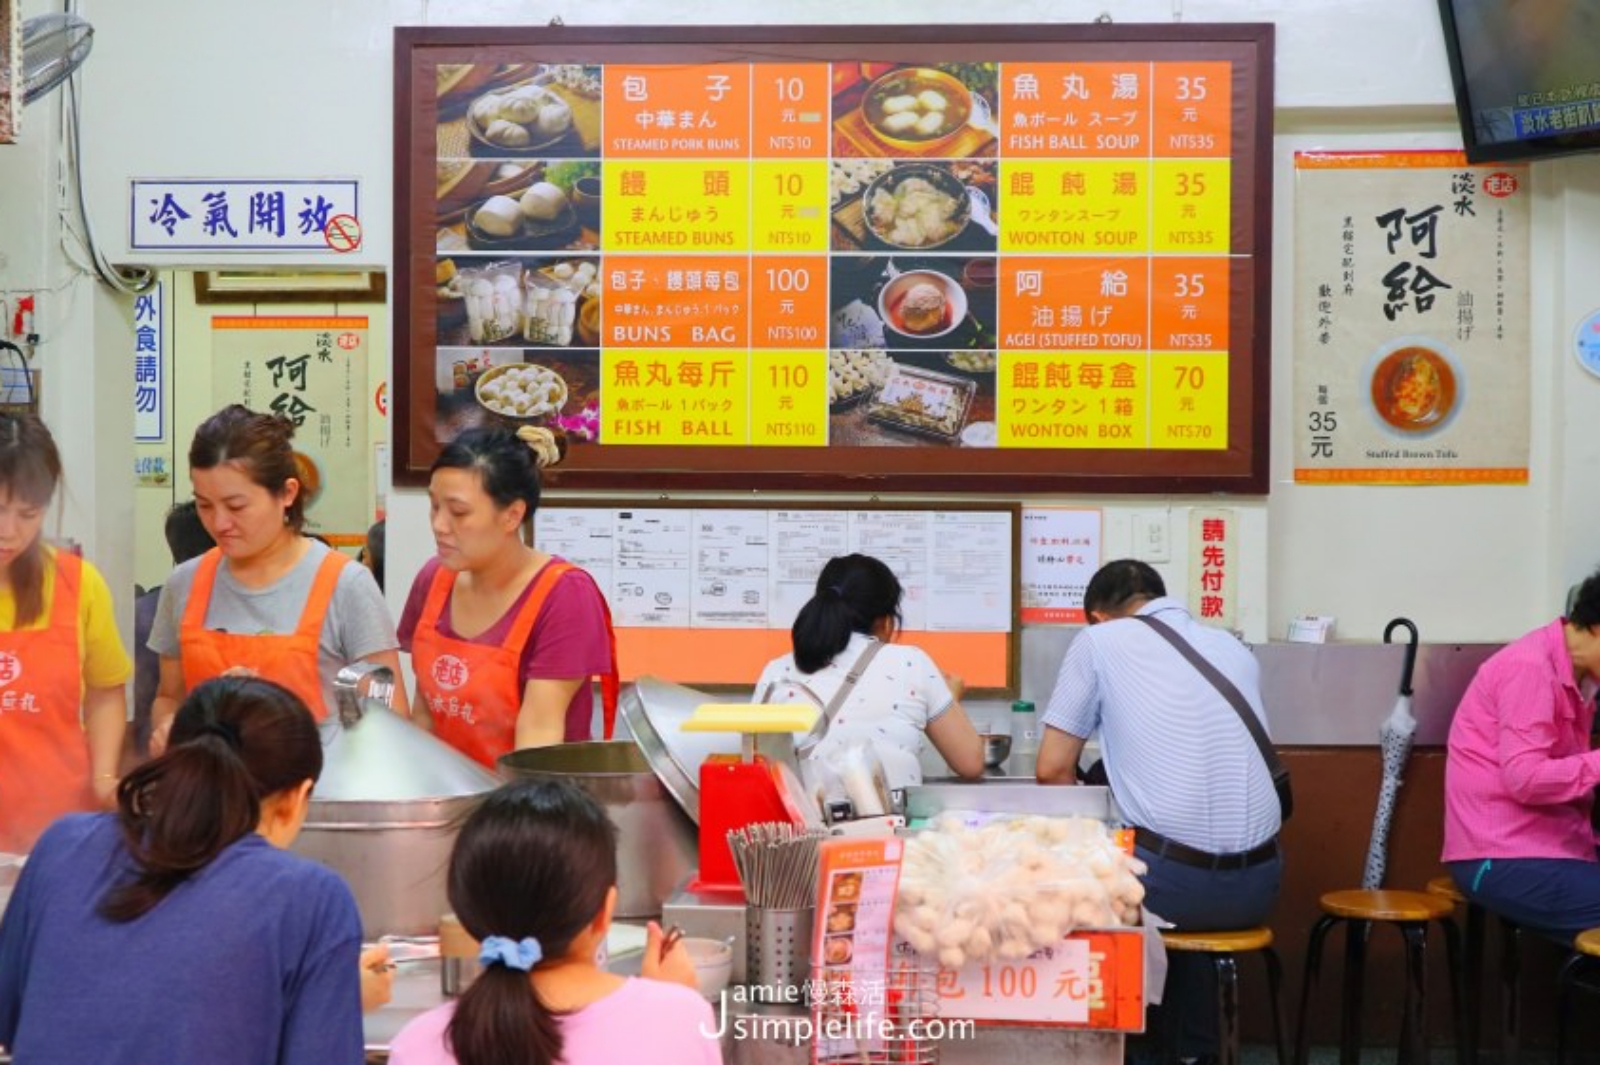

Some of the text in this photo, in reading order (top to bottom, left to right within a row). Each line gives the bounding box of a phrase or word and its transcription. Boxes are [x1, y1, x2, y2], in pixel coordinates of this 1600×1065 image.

[622, 74, 732, 102] 包子
[776, 78, 803, 101] 10
[1012, 73, 1140, 100] 魚丸湯
[1176, 76, 1207, 101] 35
[634, 110, 717, 129] 中華まん
[781, 109, 796, 123] 元
[1088, 111, 1138, 126] スープ
[1181, 107, 1198, 123] 元
[613, 138, 740, 150] STEAMED PORK BUNS
[1010, 134, 1140, 150] FISH BALL SOUP
[620, 170, 730, 197] 饅頭
[776, 174, 803, 196] 10
[1010, 171, 1138, 197] 餛飩湯
[1175, 172, 1207, 197] 35
[1451, 171, 1477, 217] 淡水
[149, 190, 335, 238] 冷氣開放
[631, 206, 719, 224] まんじゅう
[780, 205, 795, 219] 元
[1018, 208, 1121, 223] ワンタンスープ
[1181, 203, 1197, 219] 元
[614, 231, 734, 246] STEAMED BUNS
[1009, 230, 1138, 246] WONTON SOUP
[1375, 204, 1453, 322] 阿給
[766, 269, 809, 292] 100
[1015, 270, 1128, 298] 阿給
[1174, 274, 1204, 298] 35
[778, 300, 794, 315] 元
[1031, 305, 1113, 328] 油揚げ
[1182, 305, 1198, 320] 元
[613, 326, 736, 343] BUNS BAG
[1039, 333, 1099, 347] (STUFFED
[1102, 333, 1142, 347] TOFU)
[134, 294, 157, 418] 外食請勿
[613, 360, 736, 388] 魚丸每斤
[768, 366, 809, 388] 110
[1012, 362, 1136, 389] 餛飩每盒
[1174, 366, 1204, 390] 70
[778, 396, 794, 411] 元
[1011, 399, 1087, 416] ワンタン
[1180, 397, 1195, 412] 元
[613, 420, 733, 437] FISH BALL
[1011, 424, 1133, 439] WONTON BOX
[1308, 411, 1338, 432] 35
[1310, 436, 1334, 458] 元
[1201, 519, 1225, 618] 請先付款
[980, 965, 1038, 999] 100
[1053, 968, 1088, 1001] 元
